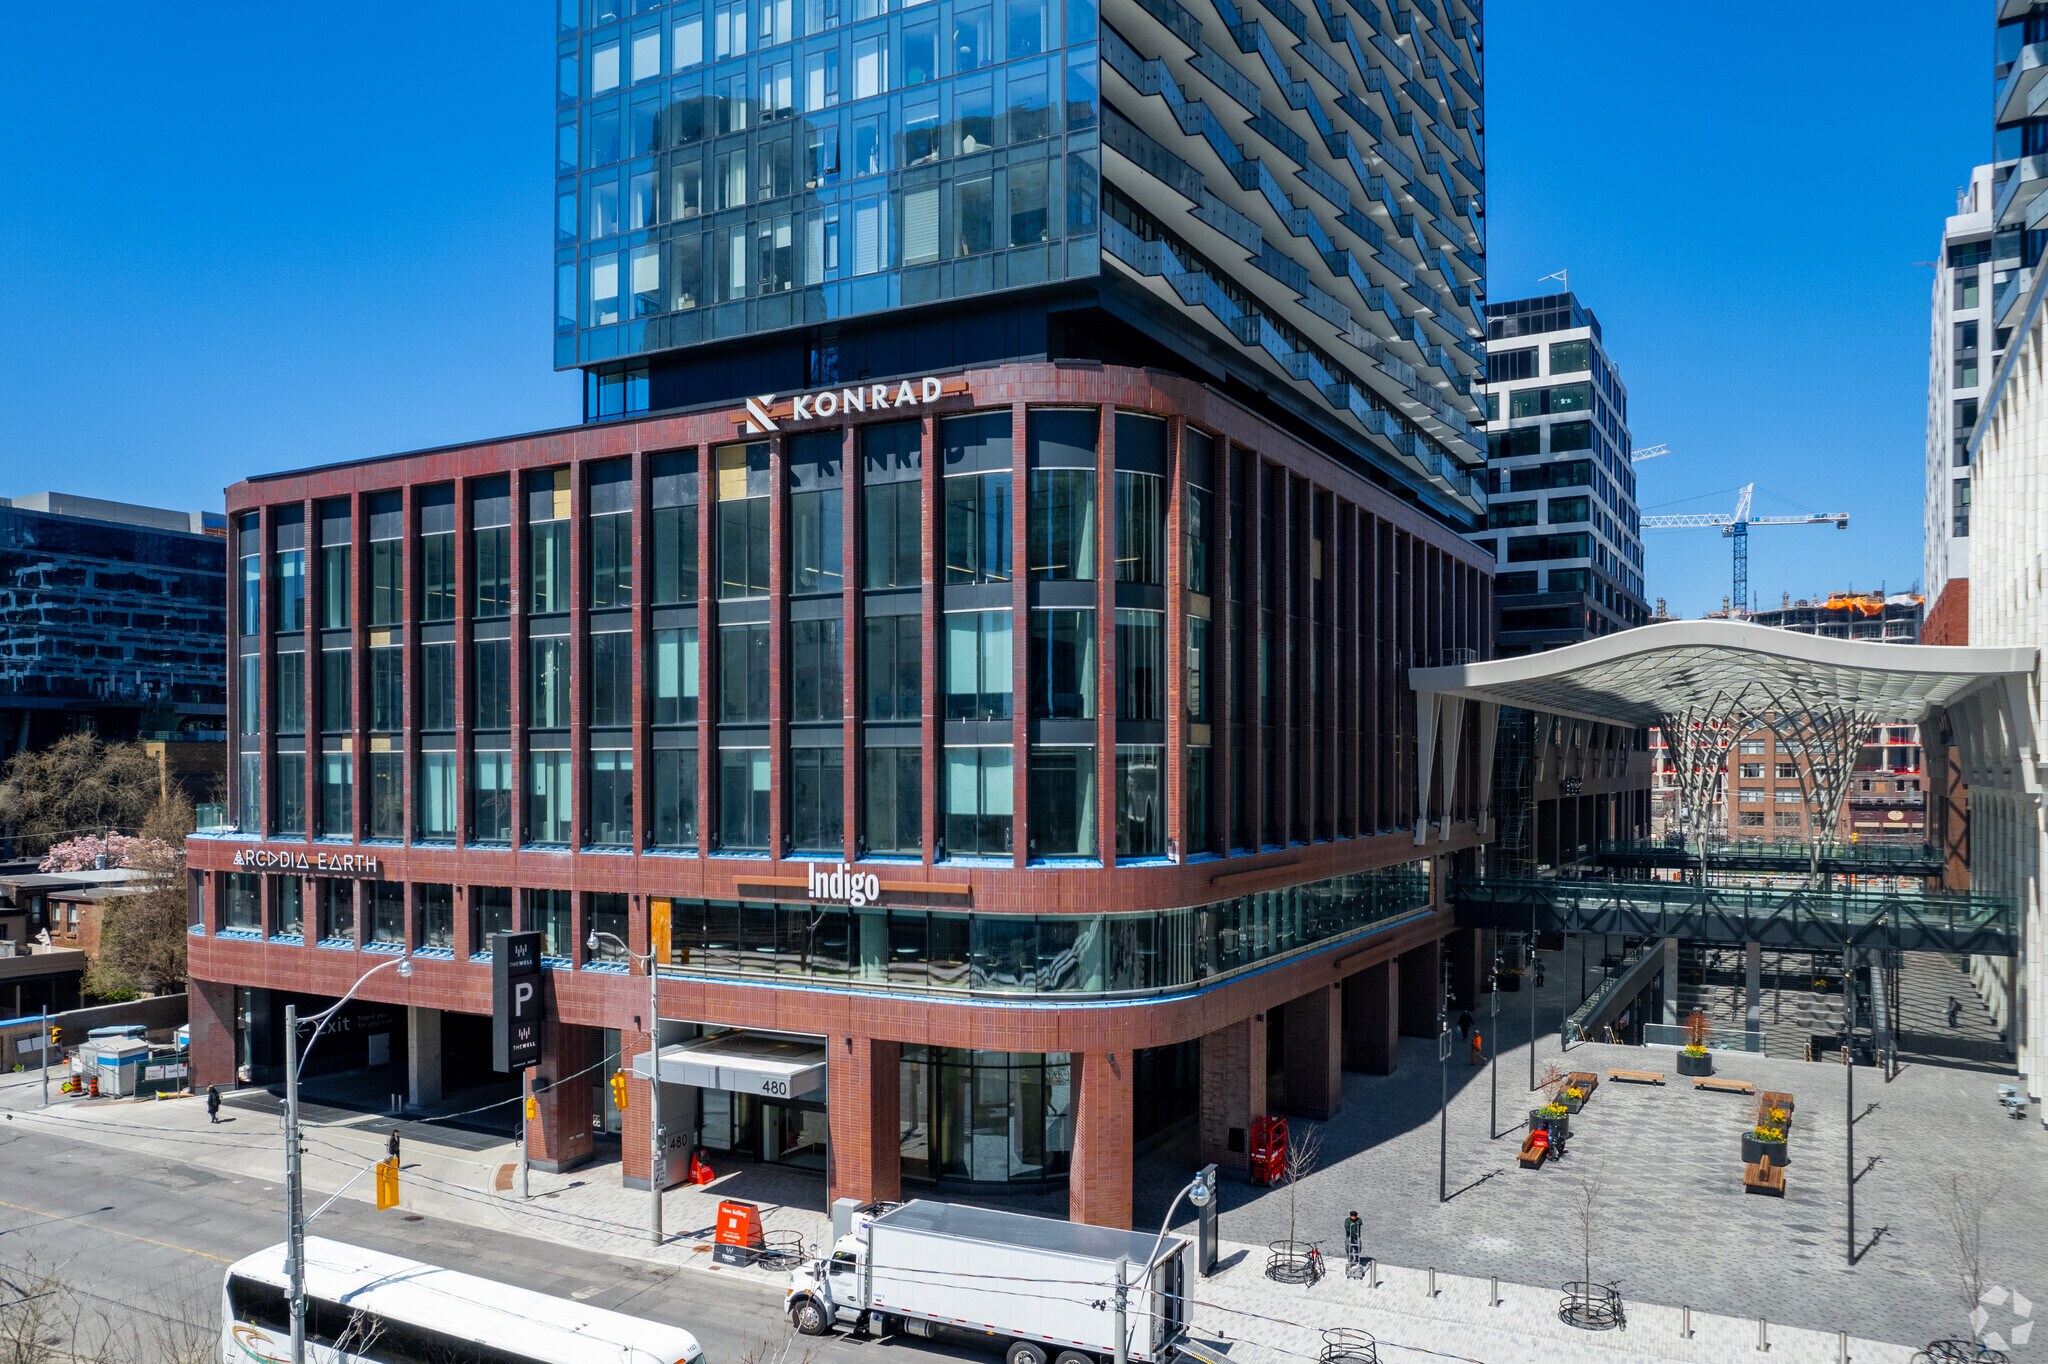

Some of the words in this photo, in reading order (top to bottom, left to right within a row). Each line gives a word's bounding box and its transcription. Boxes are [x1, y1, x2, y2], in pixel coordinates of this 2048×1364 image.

[793, 376, 943, 421] KONRAD
[318, 852, 377, 873] EARTH
[515, 982, 533, 1017] P
[762, 1080, 787, 1095] 480
[669, 1134, 688, 1150] 480
[732, 1209, 747, 1218] Selling
